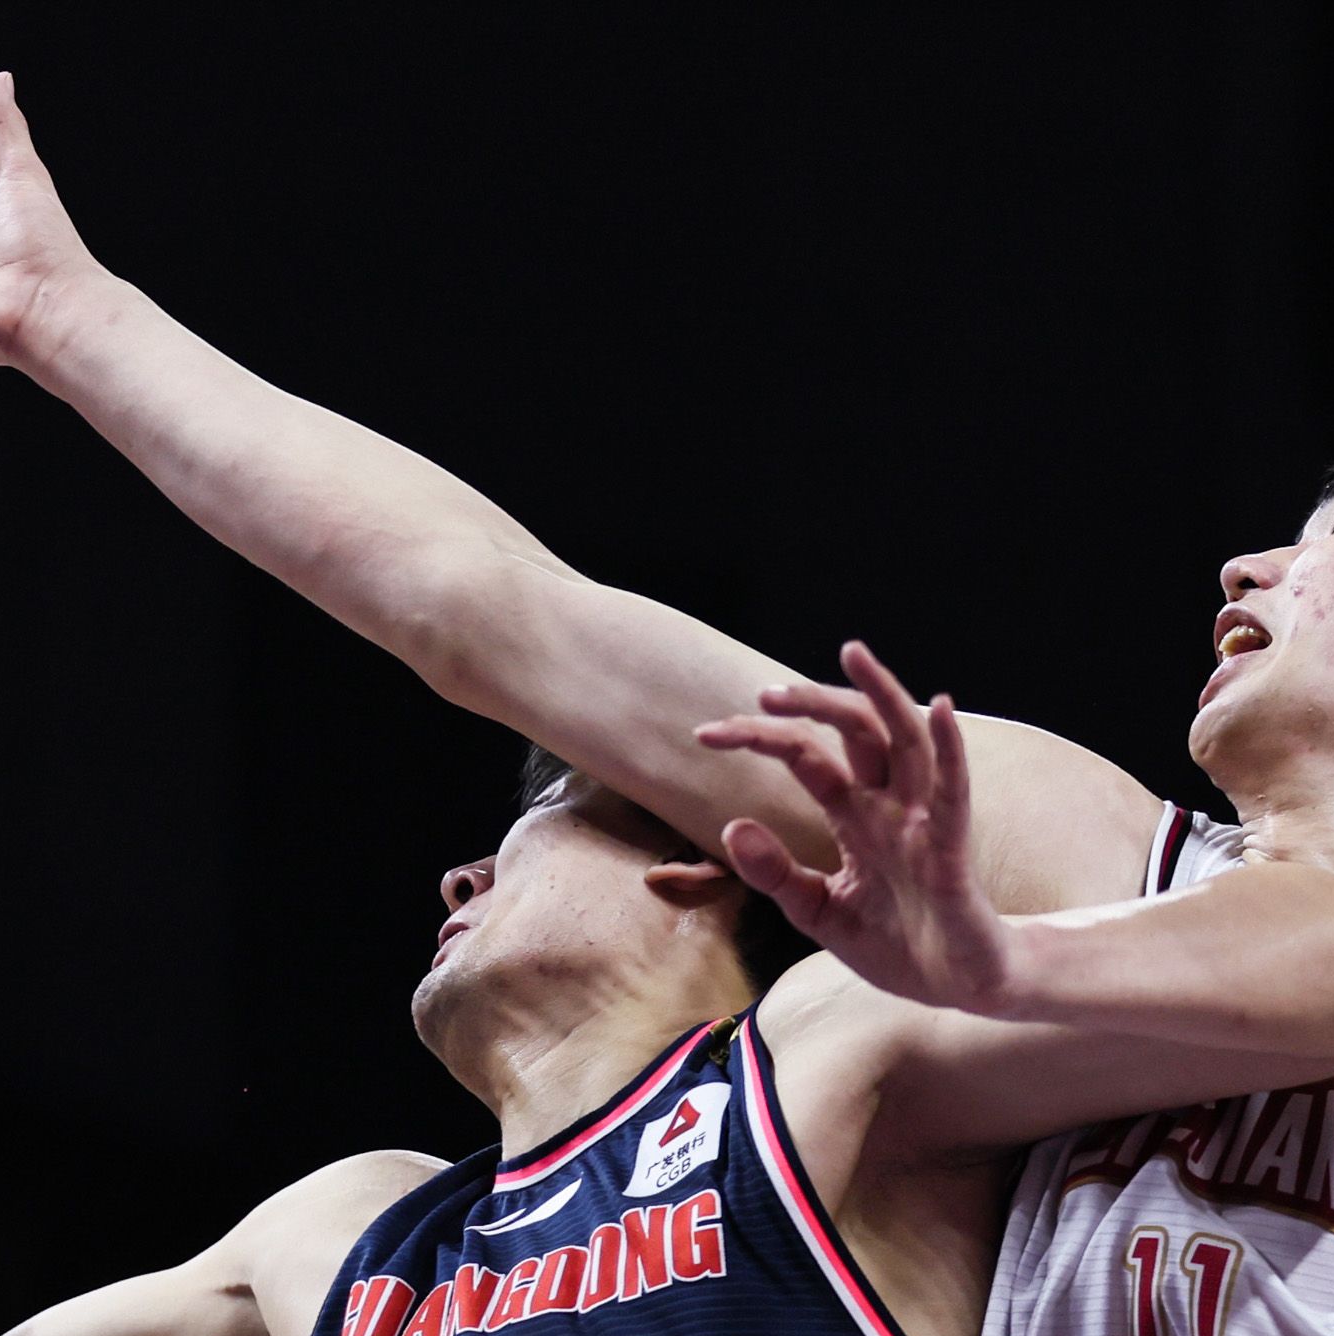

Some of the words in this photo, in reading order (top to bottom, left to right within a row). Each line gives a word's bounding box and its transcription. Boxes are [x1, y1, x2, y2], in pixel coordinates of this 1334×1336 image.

[645, 1131, 706, 1179] 广发银行
[656, 1157, 691, 1188] CGB
